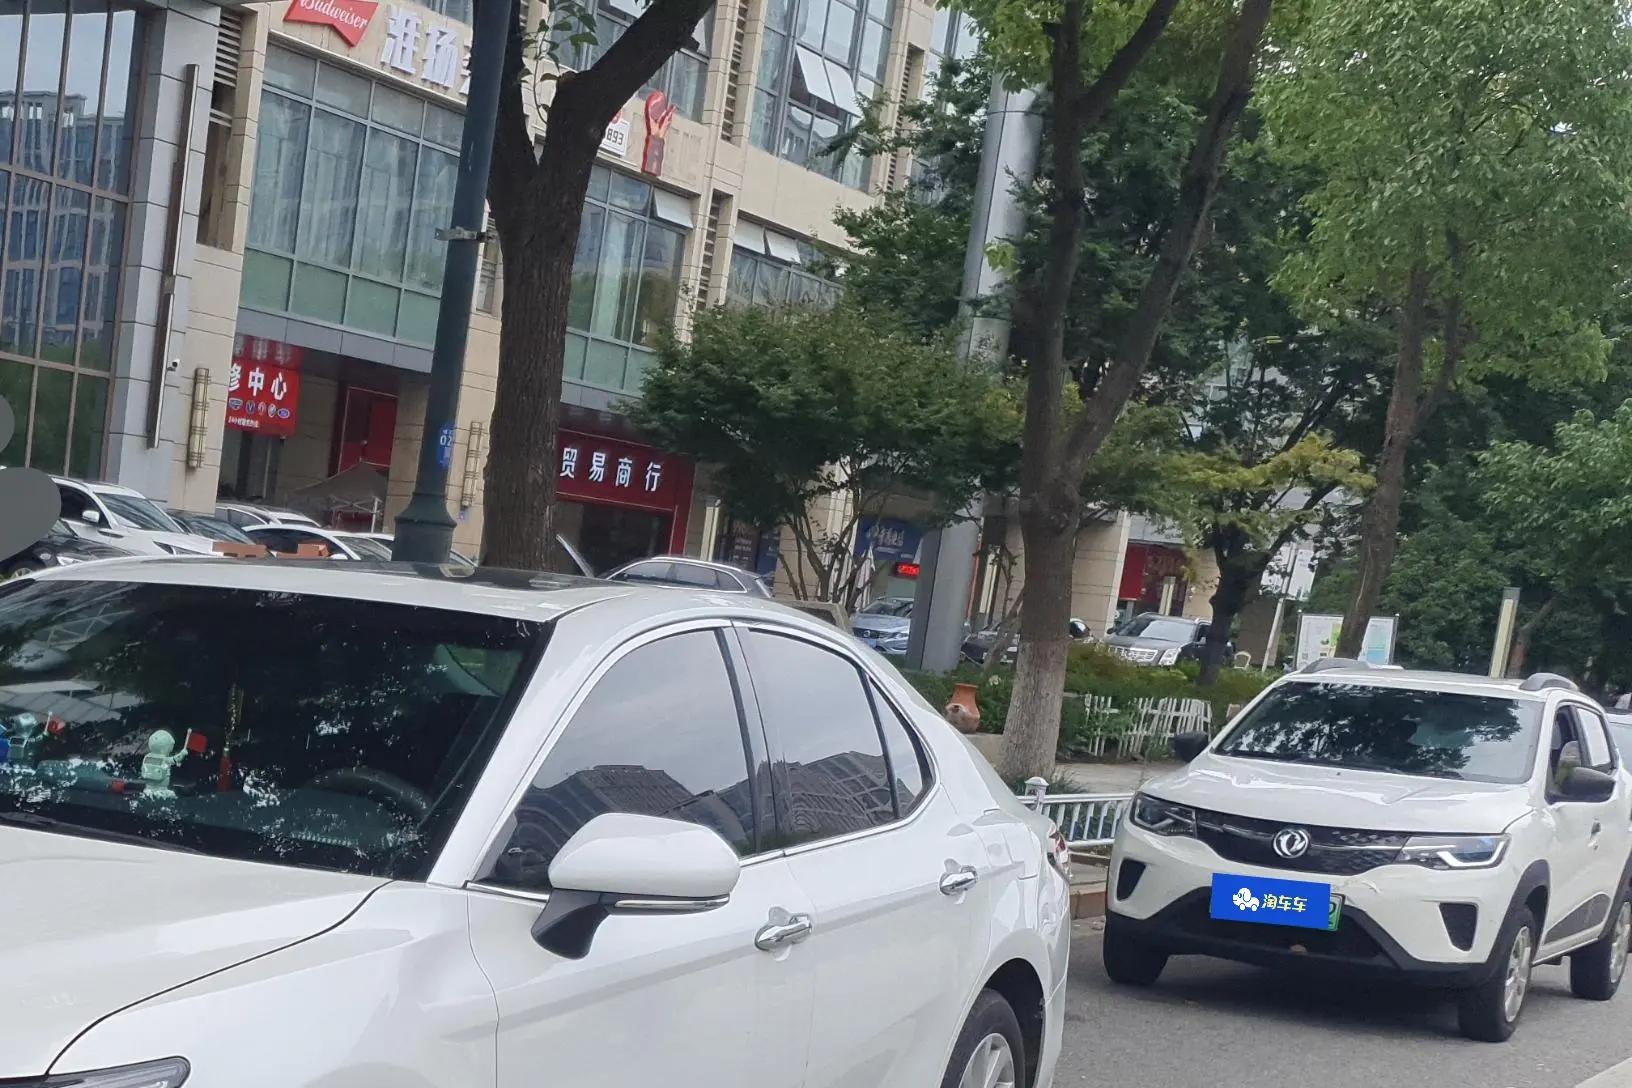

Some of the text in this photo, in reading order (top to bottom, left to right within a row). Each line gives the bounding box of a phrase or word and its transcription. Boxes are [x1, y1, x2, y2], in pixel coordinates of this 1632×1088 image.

[380, 5, 471, 94] 淮扬
[560, 447, 662, 492] 贸易商行
